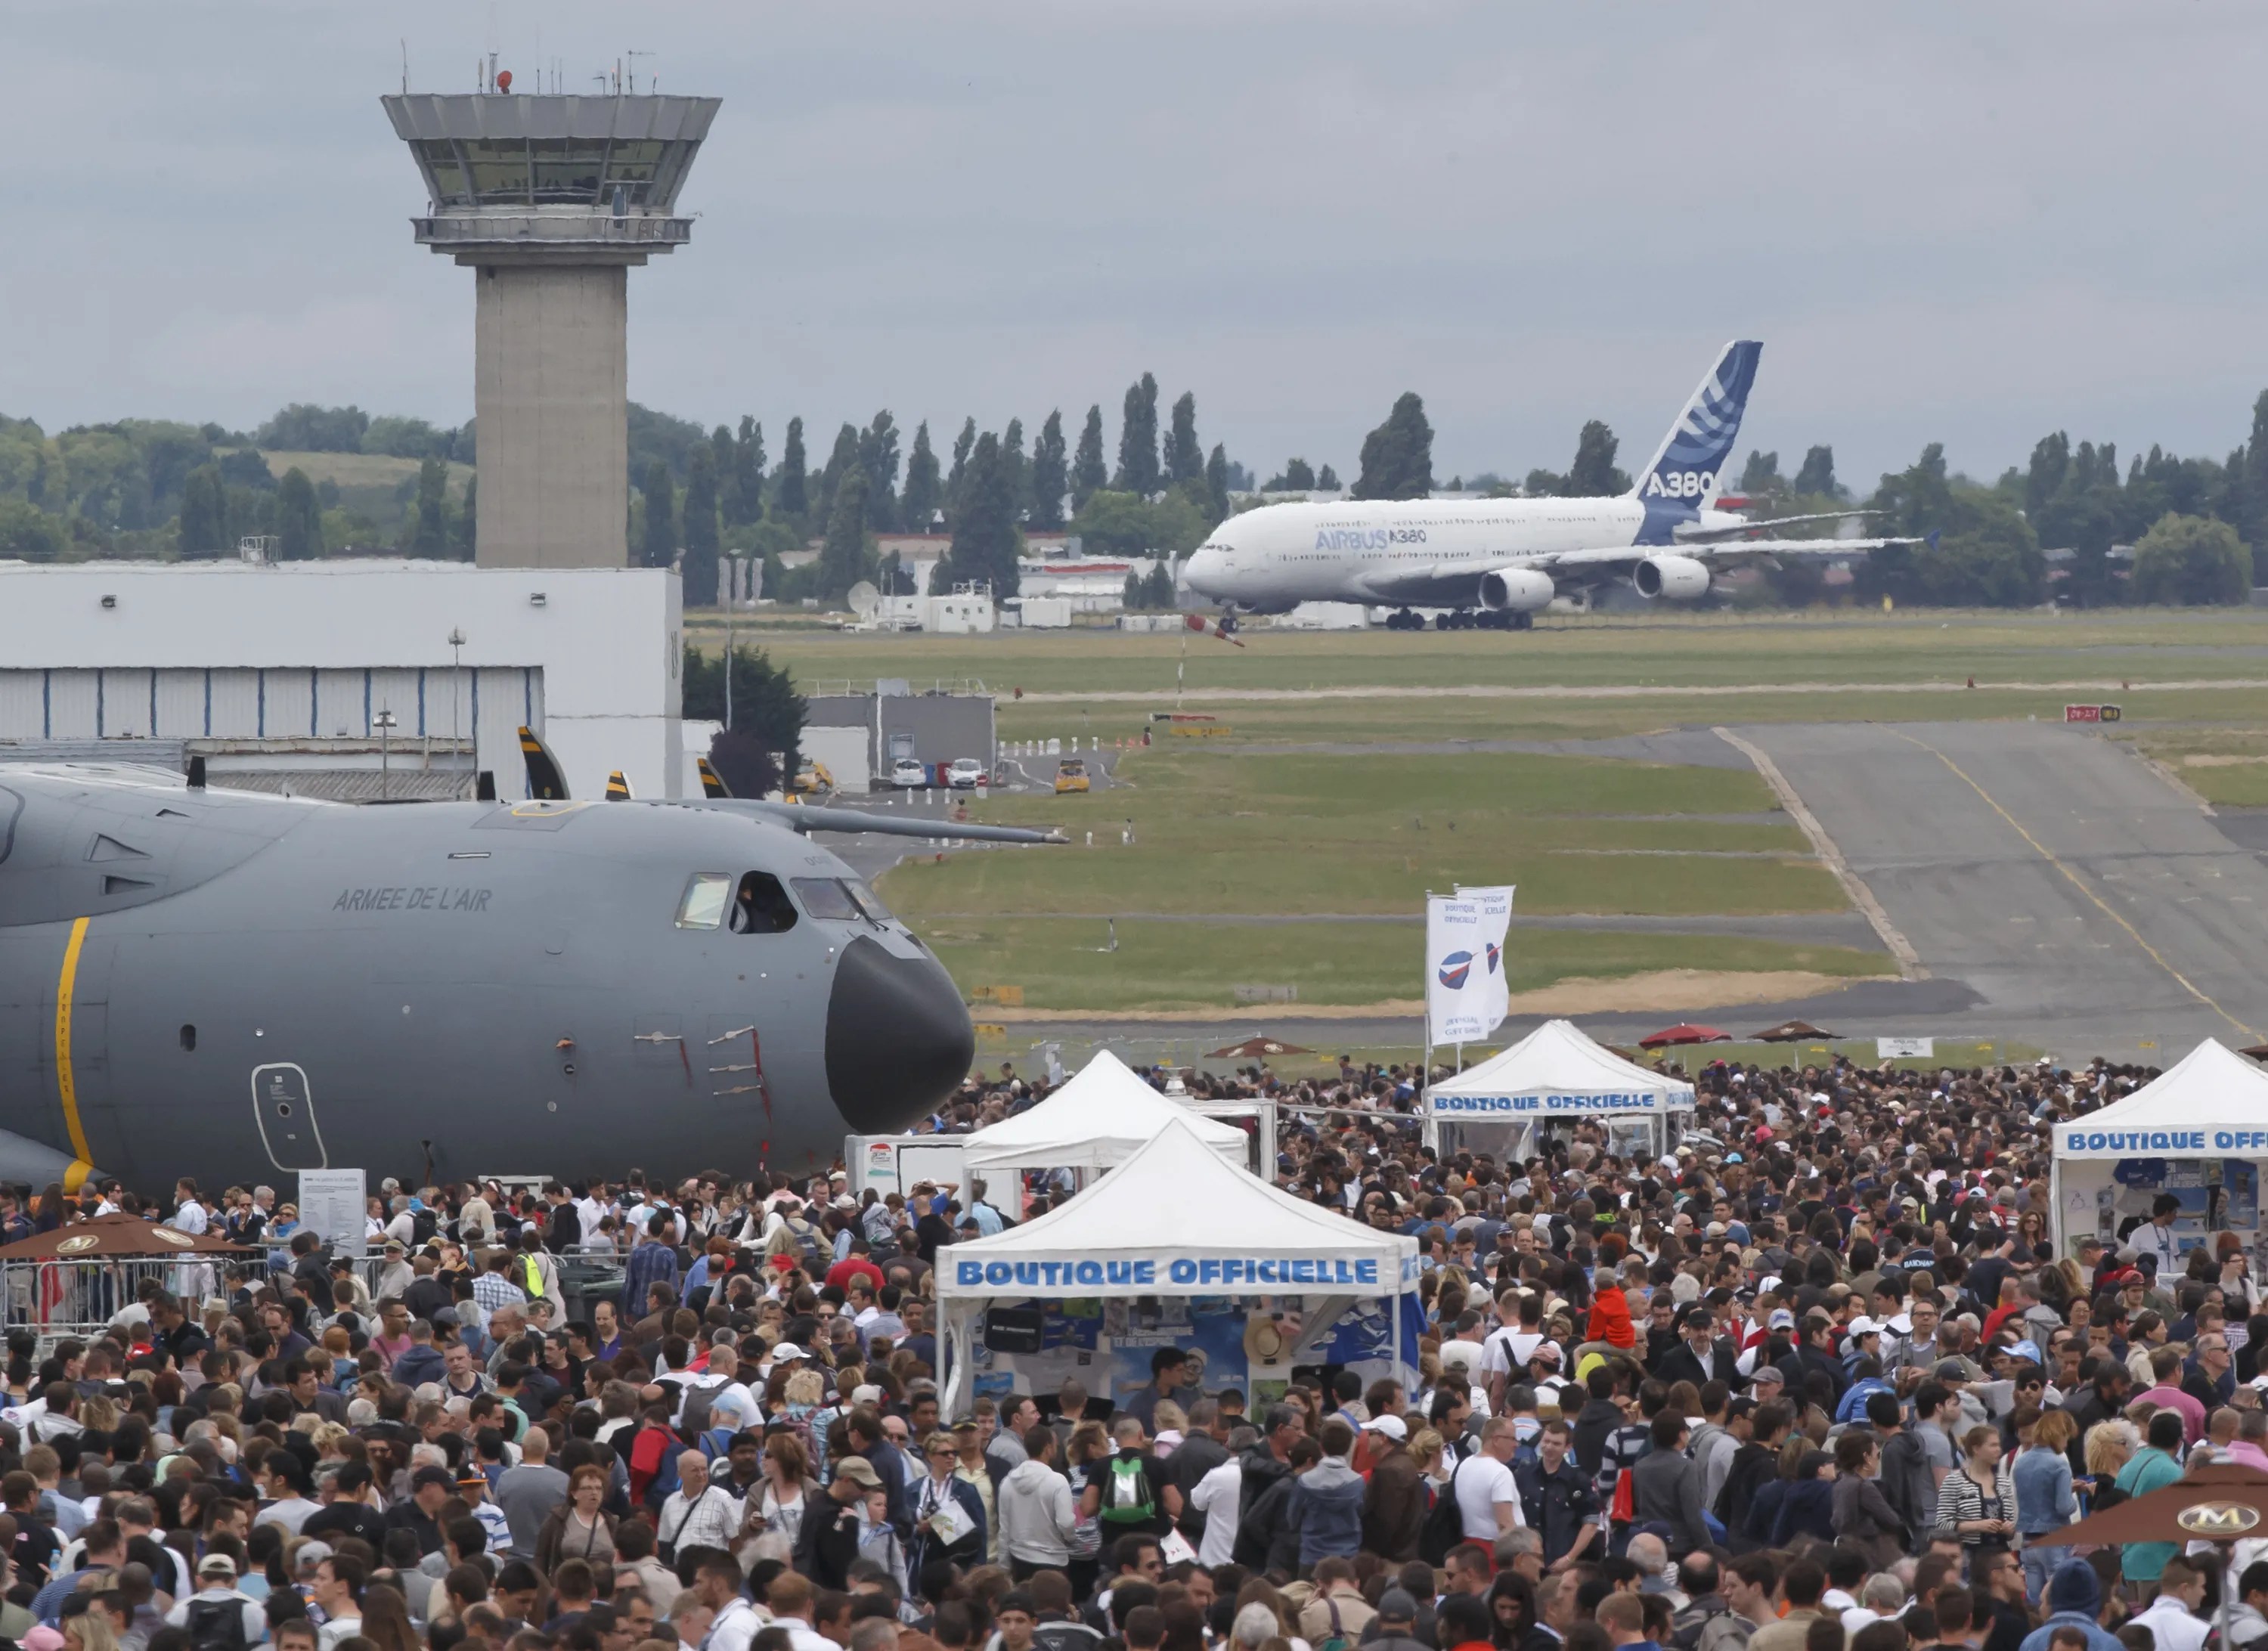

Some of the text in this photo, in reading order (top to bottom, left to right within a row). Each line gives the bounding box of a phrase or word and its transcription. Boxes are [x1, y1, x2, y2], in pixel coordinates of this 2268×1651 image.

[1647, 471, 1714, 497] A380
[1315, 529, 1427, 550] AIRBUS A380
[333, 887, 493, 911] ARMEE DE L'AIR
[1435, 1095, 1539, 1110] BOUTIQUE
[1547, 1094, 1654, 1109] OFFICIELLE
[2068, 1131, 2268, 1150] BOUTIQUE OFF
[957, 1260, 1155, 1286] BOUTIQUE
[1169, 1259, 1378, 1284] OFFICIELLE
